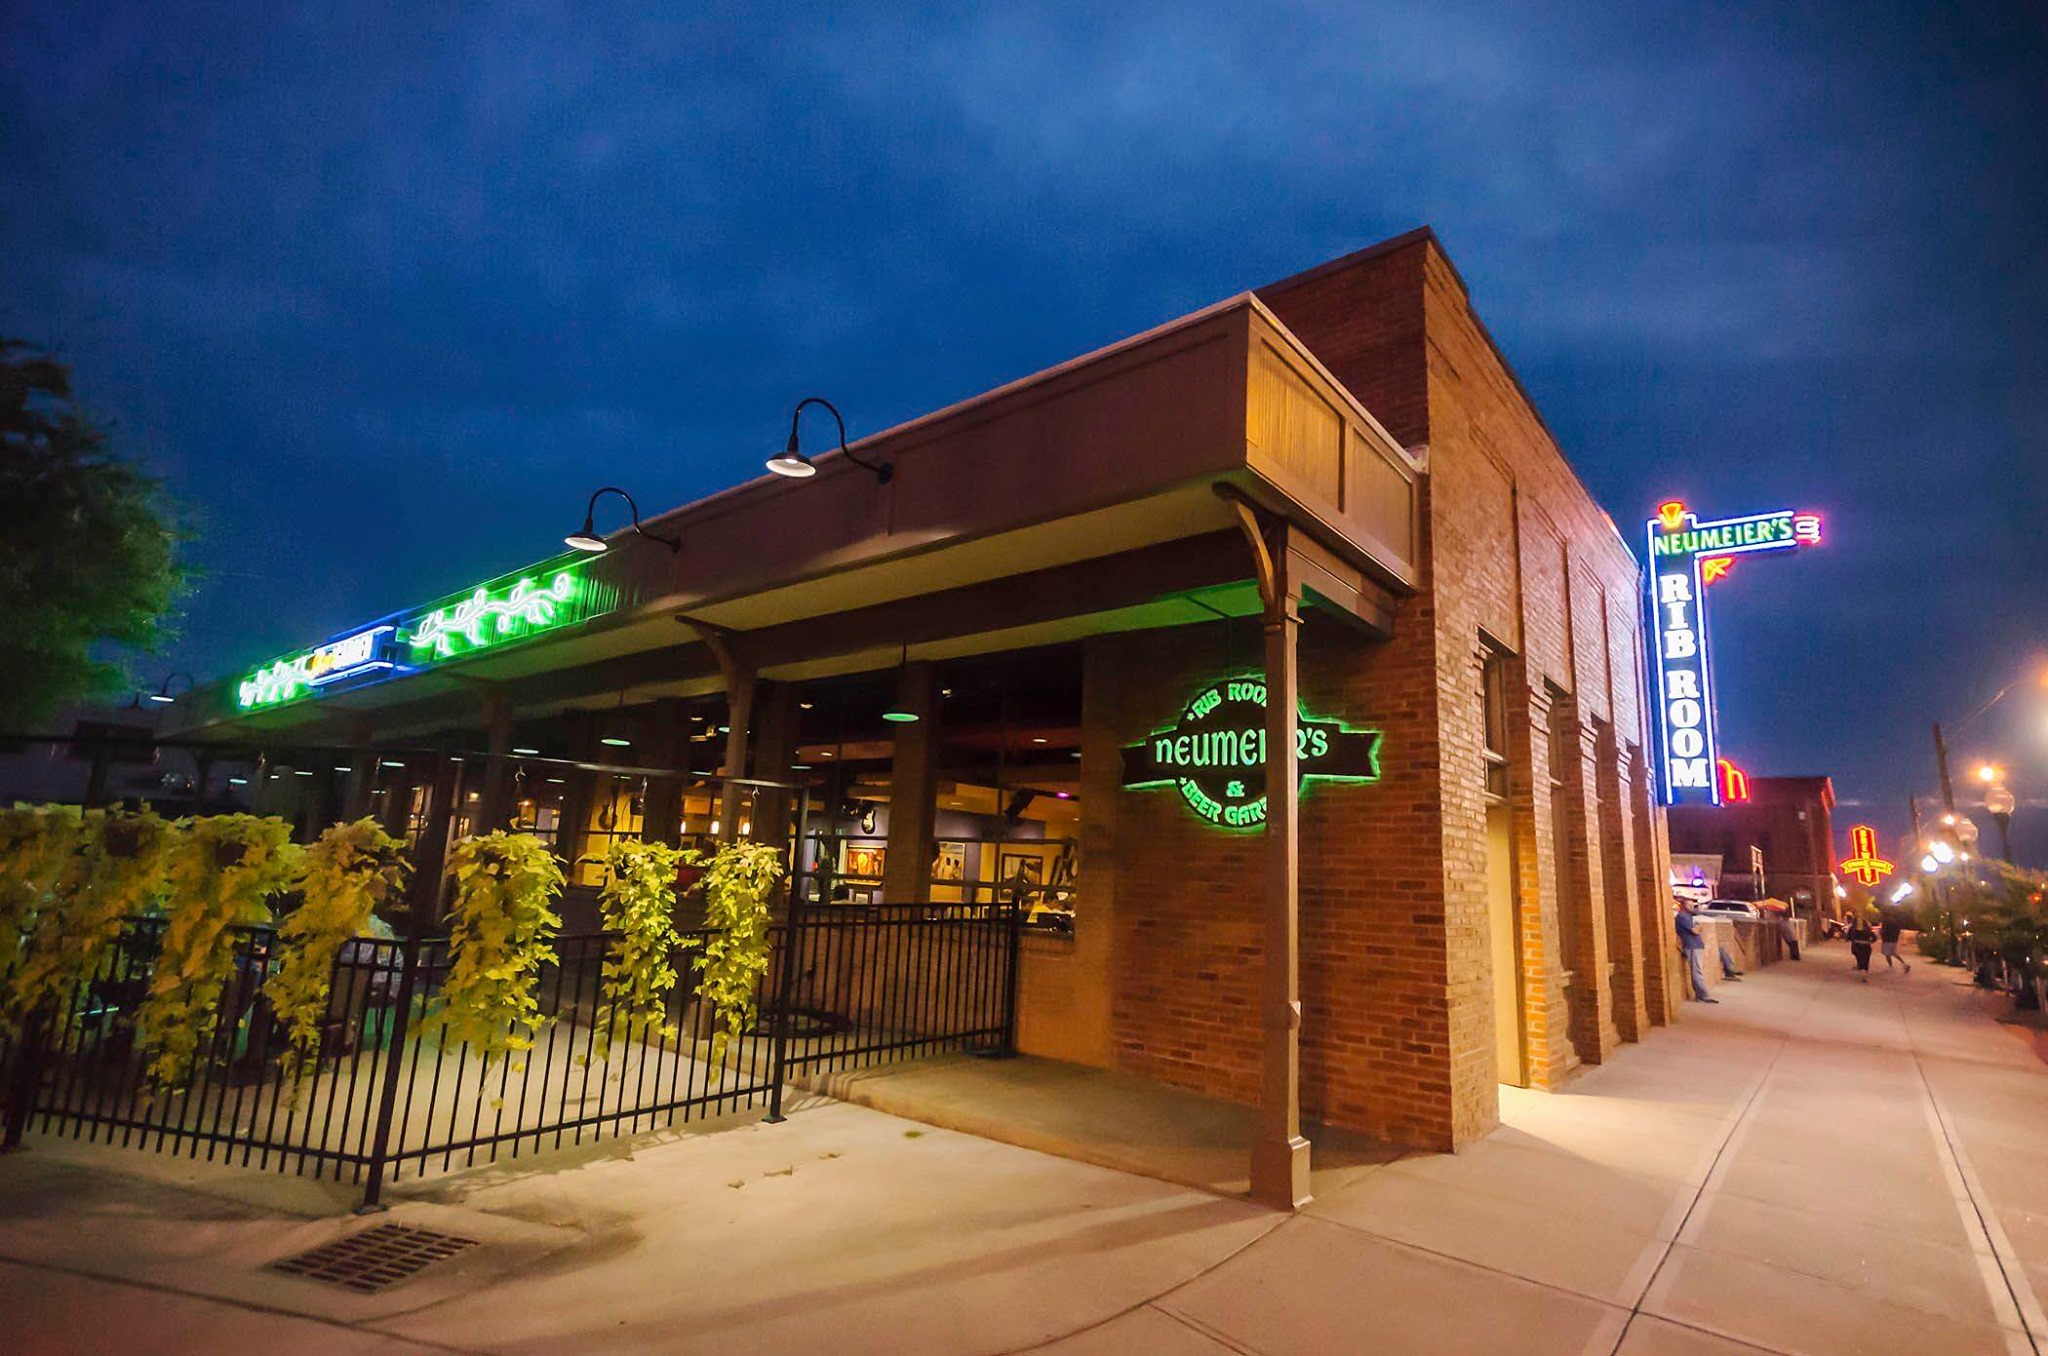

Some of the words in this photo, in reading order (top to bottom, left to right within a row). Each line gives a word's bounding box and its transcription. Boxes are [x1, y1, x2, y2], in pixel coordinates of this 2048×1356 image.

[1654, 518, 1794, 555] NEUMEIER'S
[1660, 573, 1697, 659] RIB
[1191, 689, 1222, 719] RIB
[1227, 682, 1267, 708] ROO
[1156, 728, 1328, 766] NEUMEIR'S
[1667, 669, 1710, 788] ROOM
[1181, 779, 1222, 823] BEER
[1225, 780, 1245, 797] &
